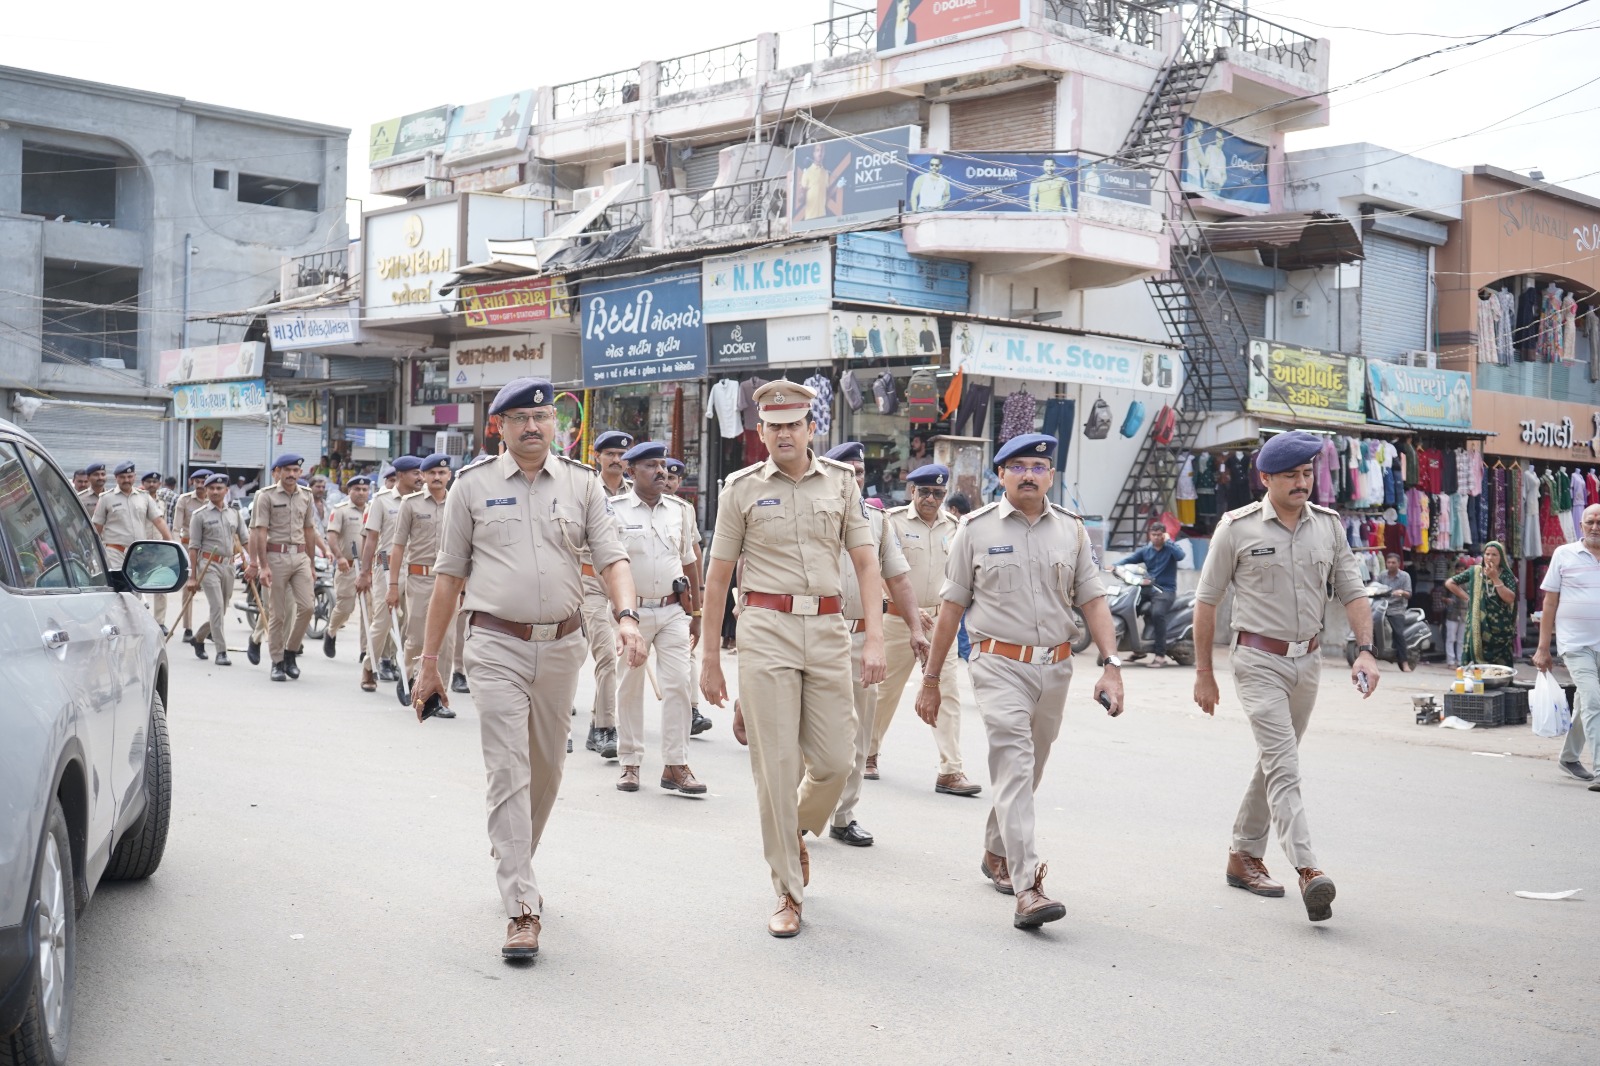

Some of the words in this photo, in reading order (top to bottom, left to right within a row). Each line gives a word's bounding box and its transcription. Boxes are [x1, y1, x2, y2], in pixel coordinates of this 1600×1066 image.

[942, 0, 976, 11] DOLL
[855, 150, 898, 169] FORCE
[976, 167, 1018, 177] DOLLAR
[377, 248, 451, 280] આરાધના
[773, 259, 821, 288] Store
[651, 304, 701, 331] મેન્સવેર
[456, 345, 511, 366] આરાધના
[719, 342, 757, 355] JOCKEY
[1066, 345, 1130, 374] Store
[1273, 361, 1344, 391] આશીર્વાદ
[1394, 369, 1448, 402] Shreeji
[1287, 385, 1330, 408] રેડીમેડ
